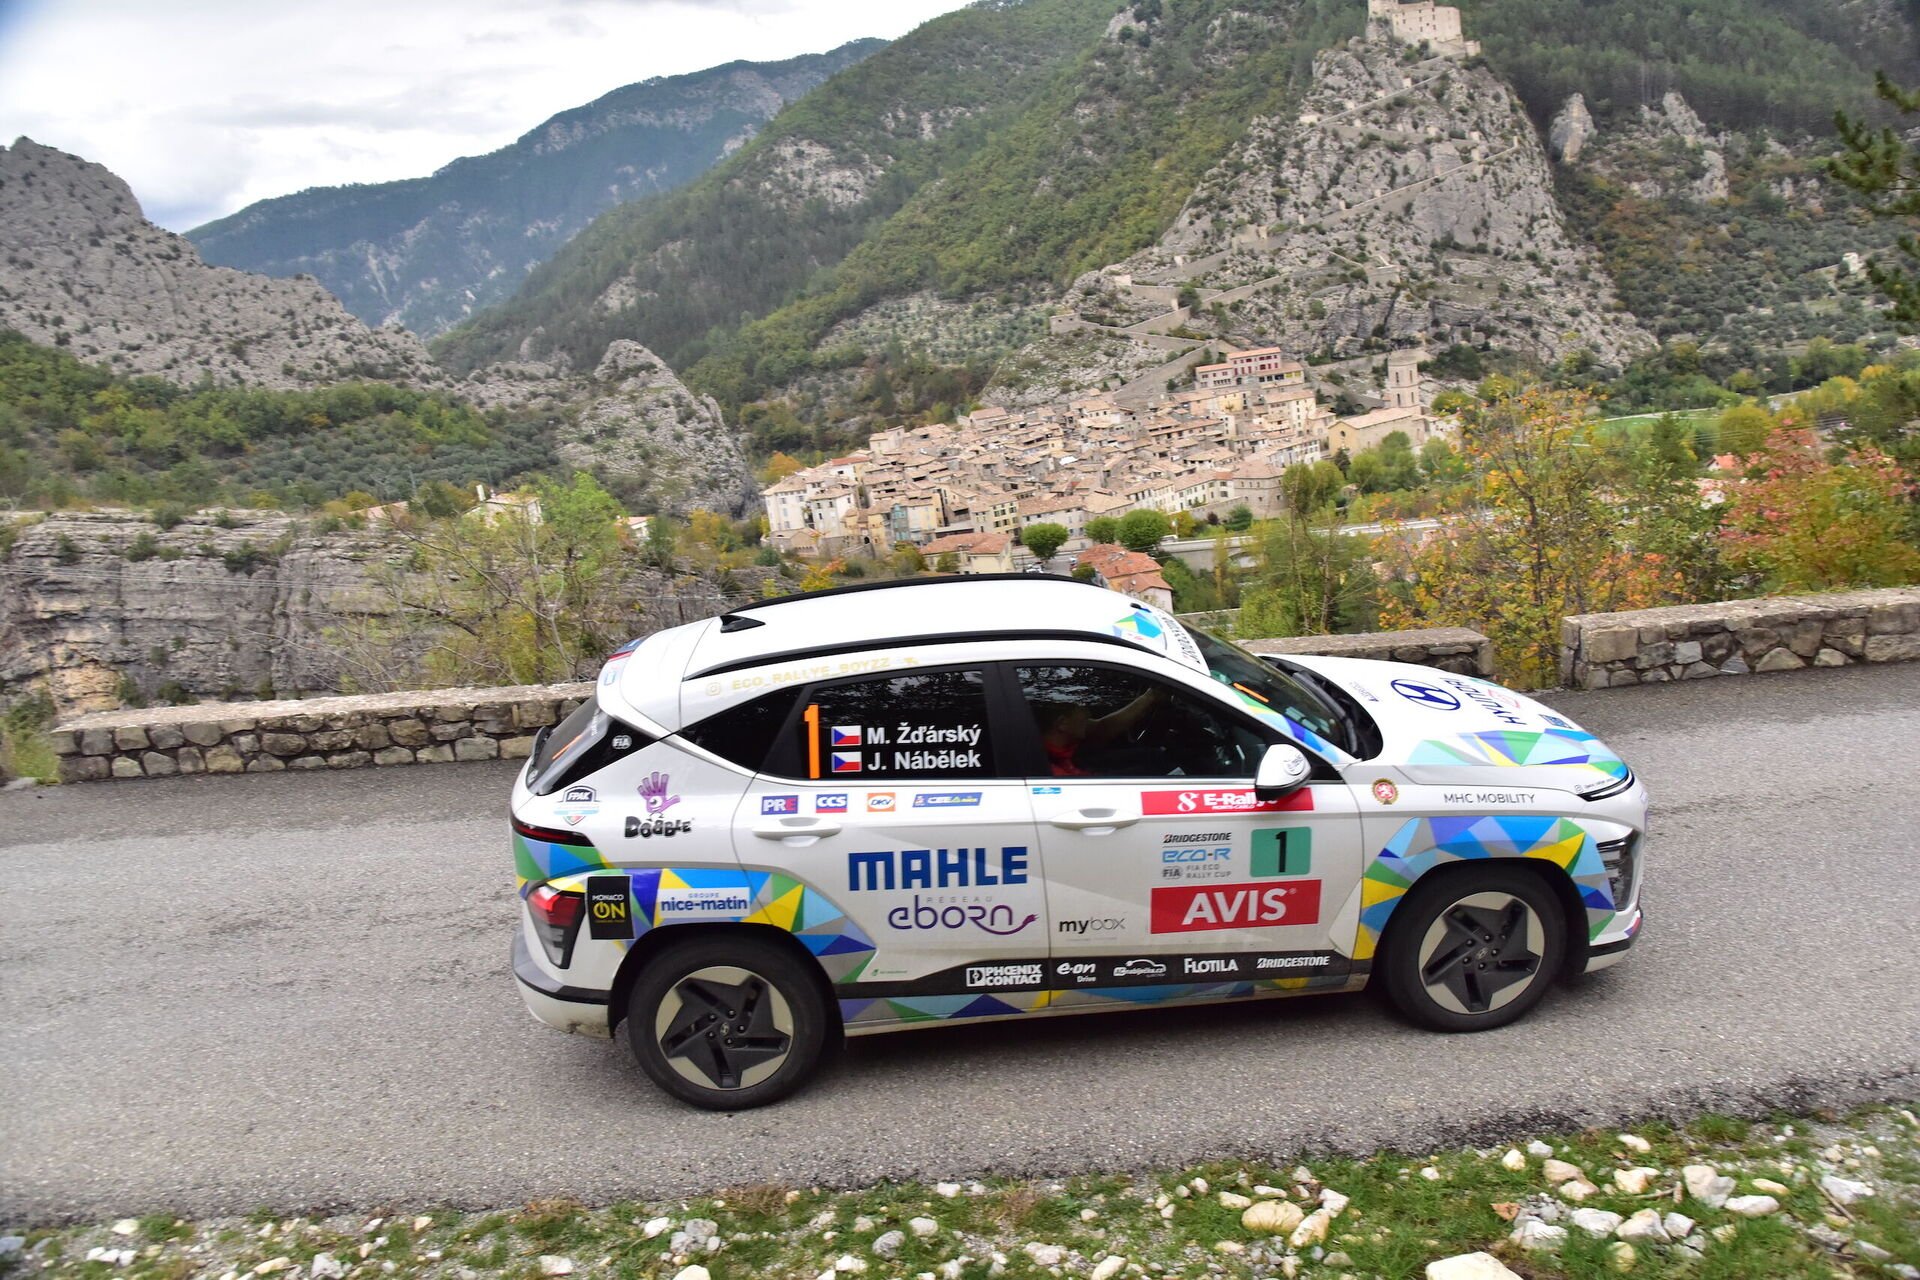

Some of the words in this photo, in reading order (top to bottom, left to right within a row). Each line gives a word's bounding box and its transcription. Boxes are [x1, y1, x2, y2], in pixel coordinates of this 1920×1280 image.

[804, 703, 821, 780] 1
[867, 727, 891, 745] M.
[896, 722, 982, 747] Žďárský
[867, 752, 887, 771] J.
[895, 749, 982, 770] Nábělek
[763, 796, 797, 812] PRE
[817, 795, 847, 806] CCS
[1444, 793, 1472, 804] MHC
[1477, 792, 1535, 804] MOBILITY
[1162, 832, 1232, 844] BRIDGESTONE
[1275, 831, 1288, 873] 1
[848, 846, 1028, 891] MAHLE
[593, 901, 625, 918] ON
[661, 896, 748, 912] nice-matin
[1181, 887, 1288, 926] AVIS
[1058, 916, 1126, 935] mybox
[1183, 957, 1239, 974] FLOTILA
[1256, 955, 1331, 969] BRIDGESTONE
[985, 973, 1043, 986] CONTACT
